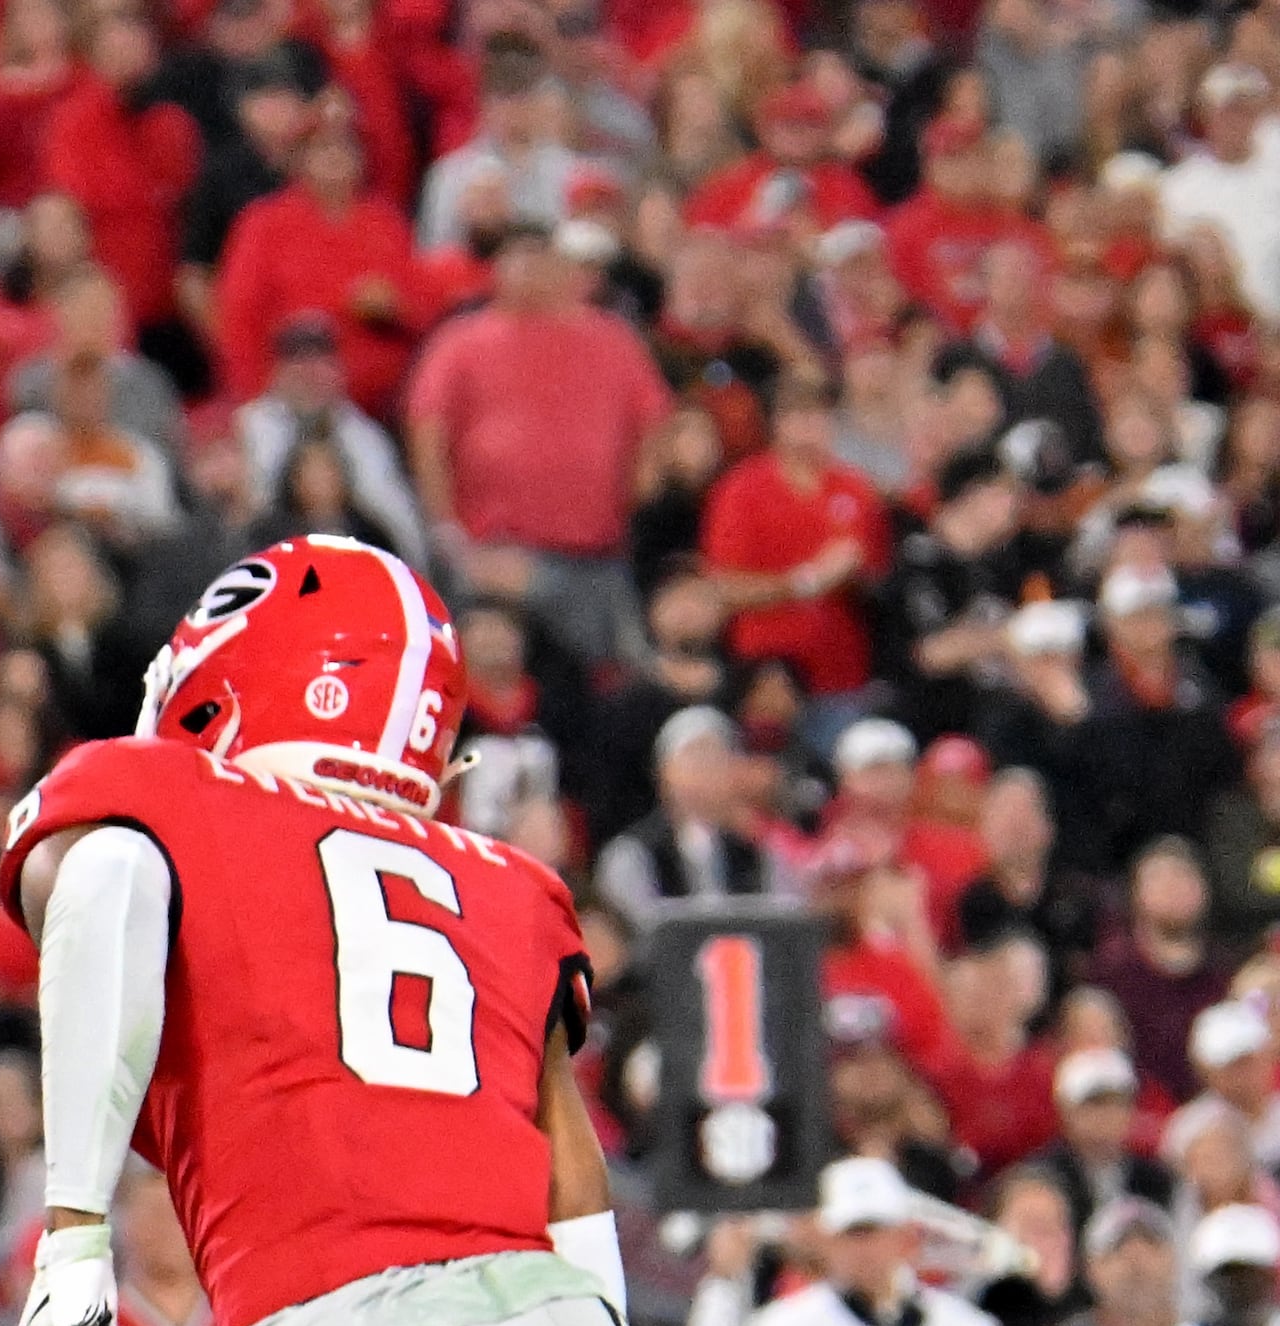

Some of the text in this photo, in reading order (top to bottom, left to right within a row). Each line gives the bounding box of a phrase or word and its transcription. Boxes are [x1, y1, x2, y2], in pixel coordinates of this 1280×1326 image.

[312, 683, 342, 710] SEC
[408, 689, 443, 752] 6
[317, 827, 480, 1097] 6
[698, 936, 771, 1098] 1
